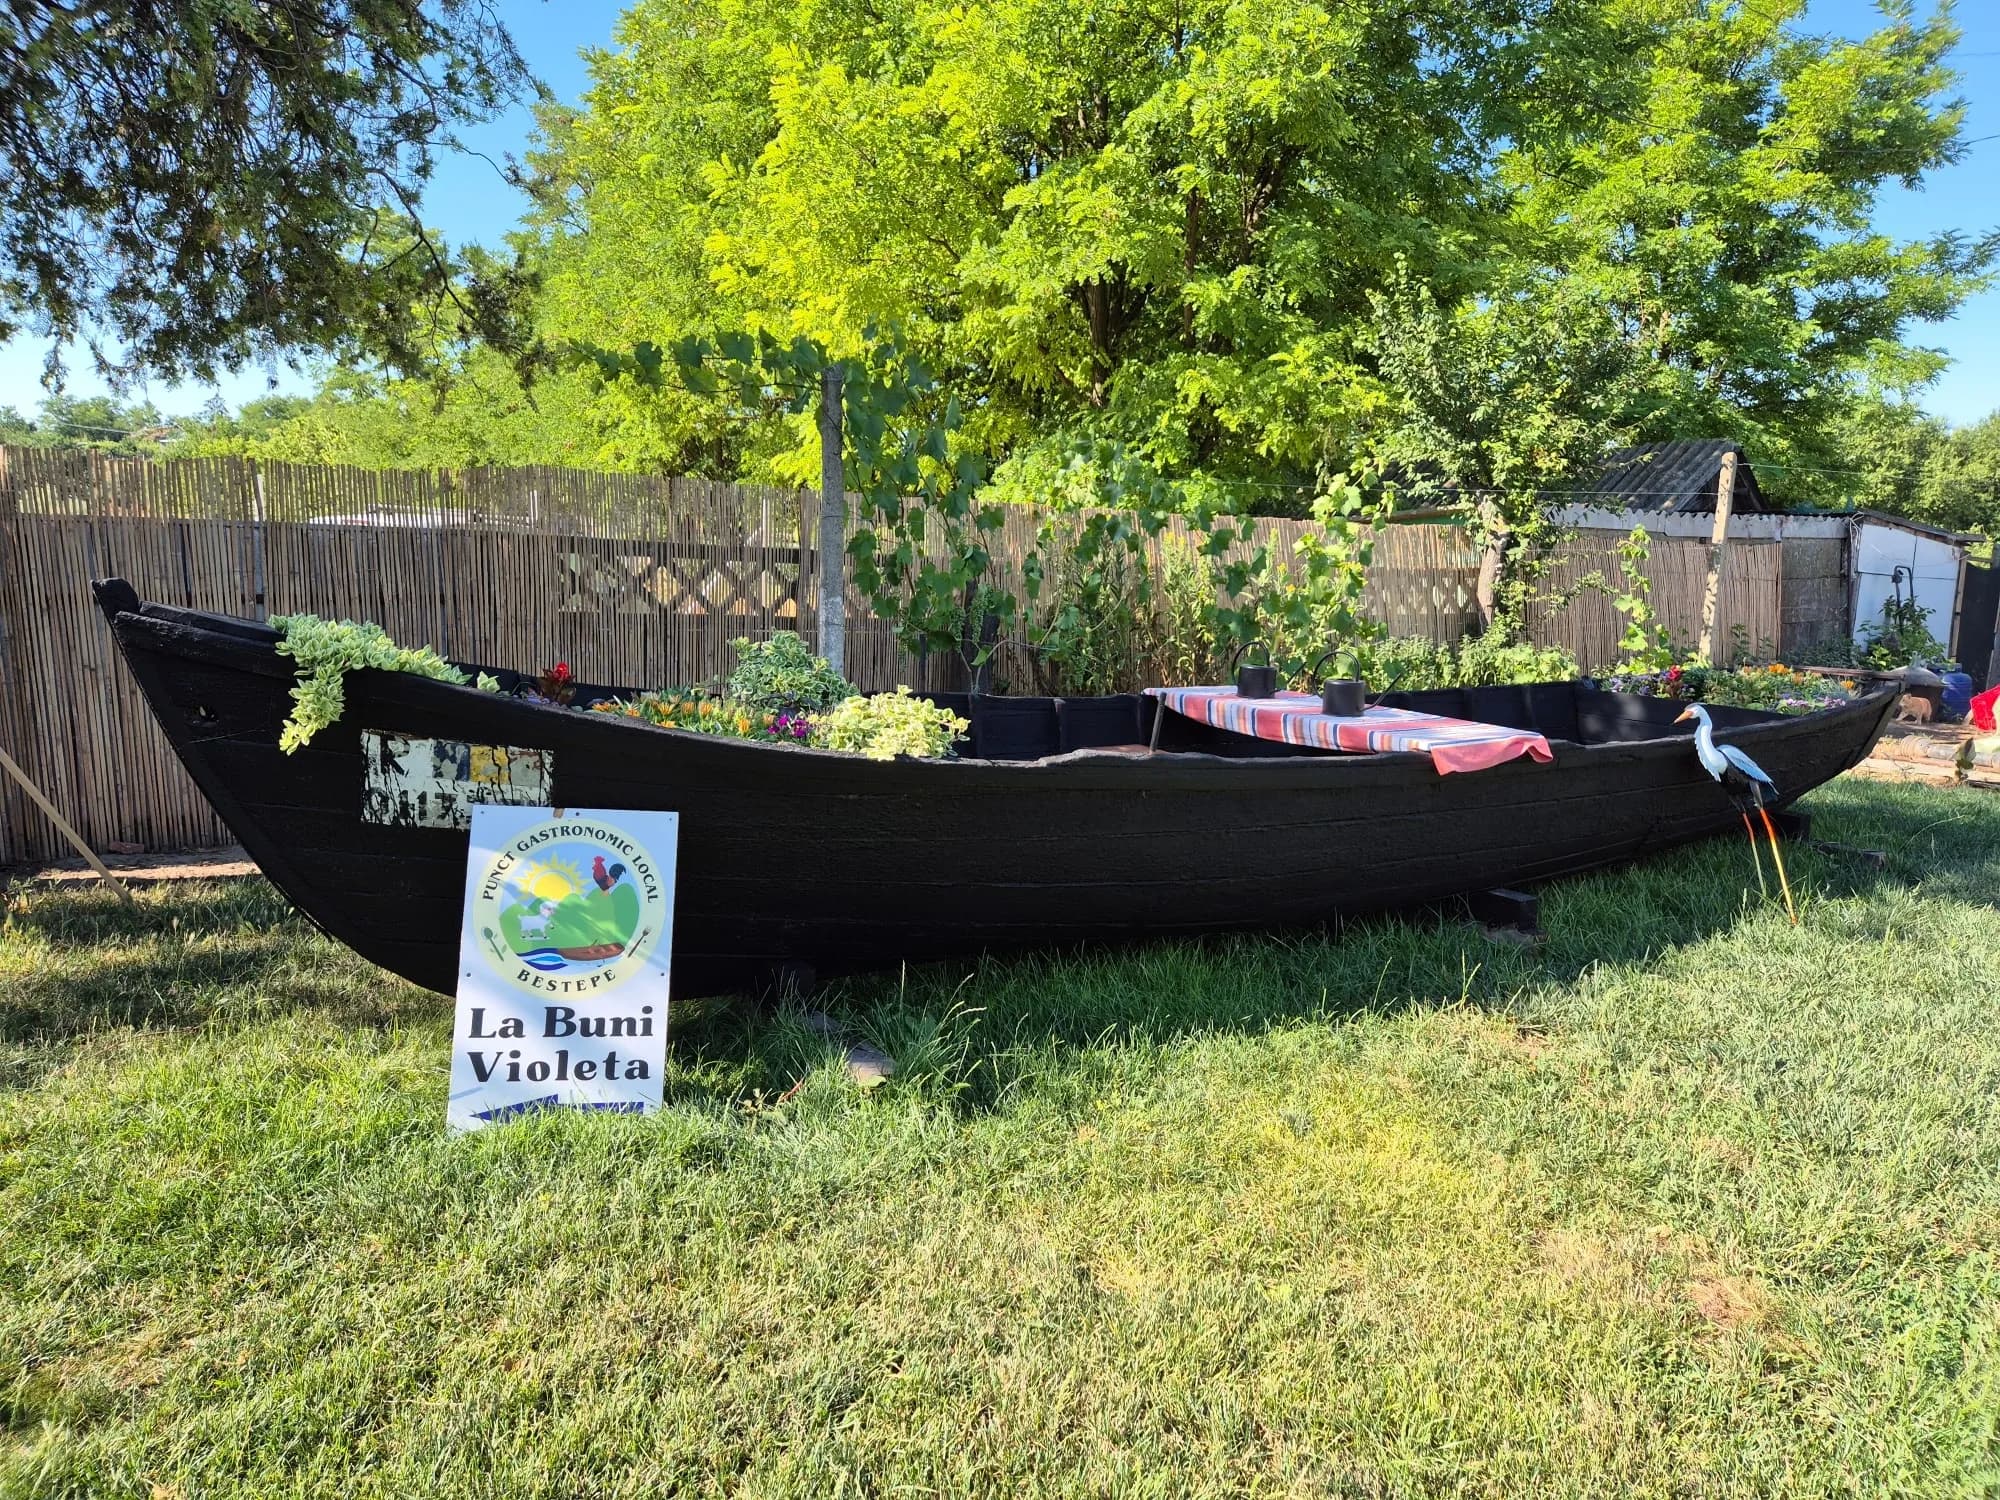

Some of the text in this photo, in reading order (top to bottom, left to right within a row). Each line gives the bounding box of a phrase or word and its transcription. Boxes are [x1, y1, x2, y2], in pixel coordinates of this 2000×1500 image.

[483, 825, 659, 903] PUNCT GASTRONOMIC LOCAL
[517, 969, 616, 992] BESTEPE
[468, 1005, 653, 1038] La Buni
[467, 1049, 651, 1082] Violeta
